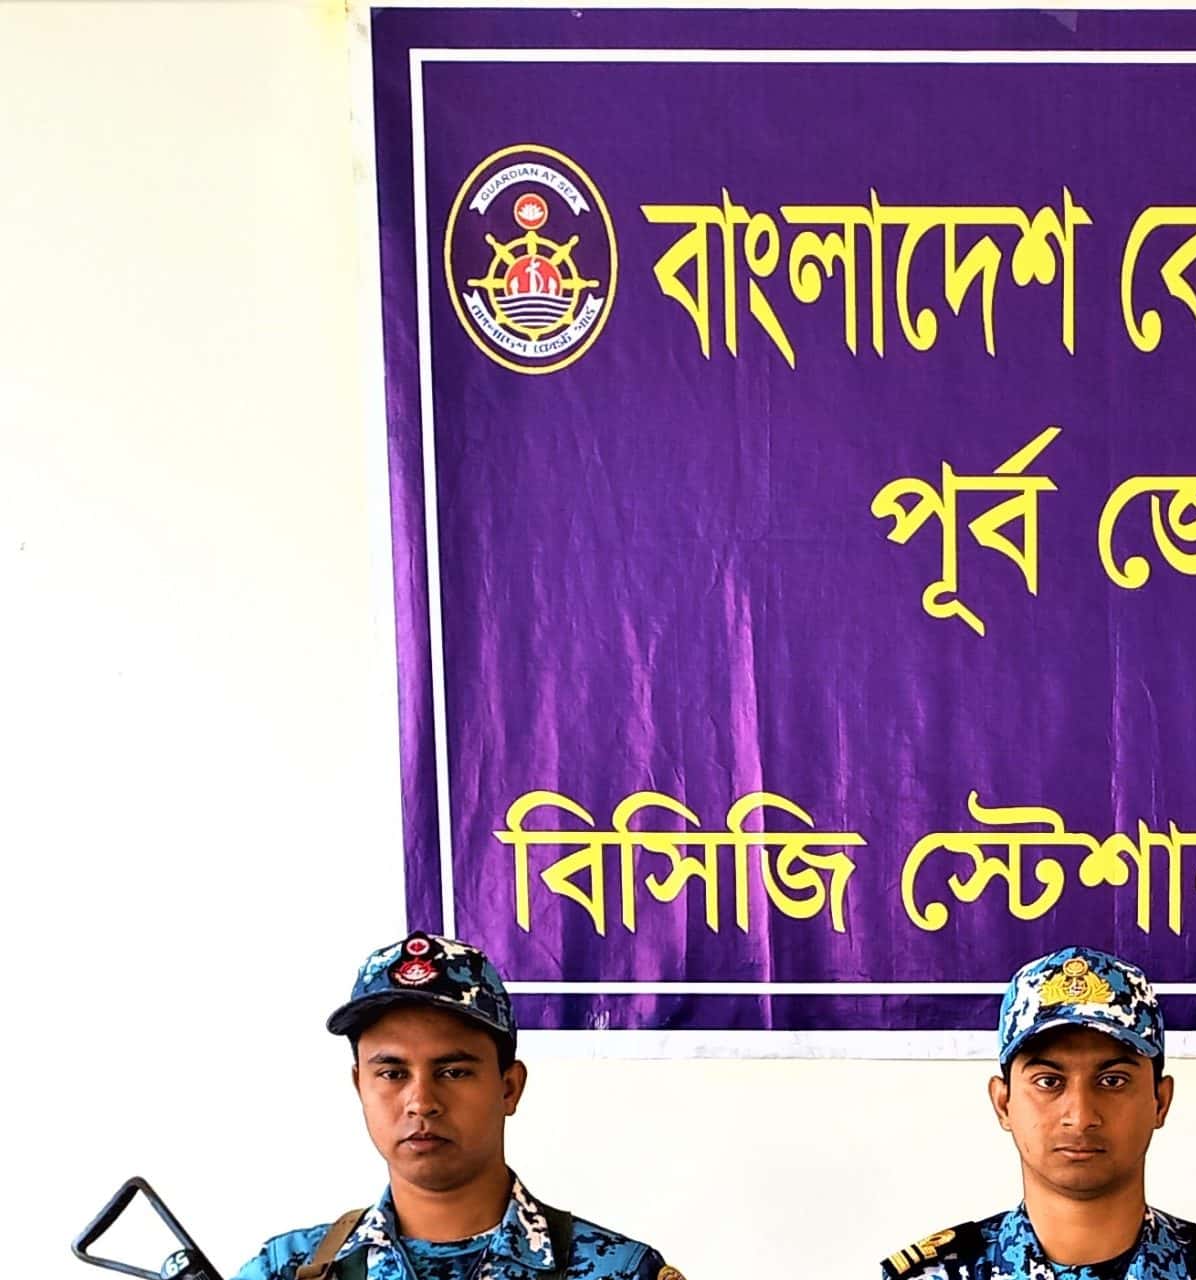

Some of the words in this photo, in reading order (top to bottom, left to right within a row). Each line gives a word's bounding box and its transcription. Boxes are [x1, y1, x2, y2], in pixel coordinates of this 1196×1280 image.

[480, 168, 539, 201] GUARDIAN
[541, 171, 557, 183] AT
[557, 181, 577, 203] SEA
[640, 186, 1093, 369] বাংলাদেশ
[870, 426, 1062, 636] পূর্ব
[493, 790, 868, 936] বিসিজি
